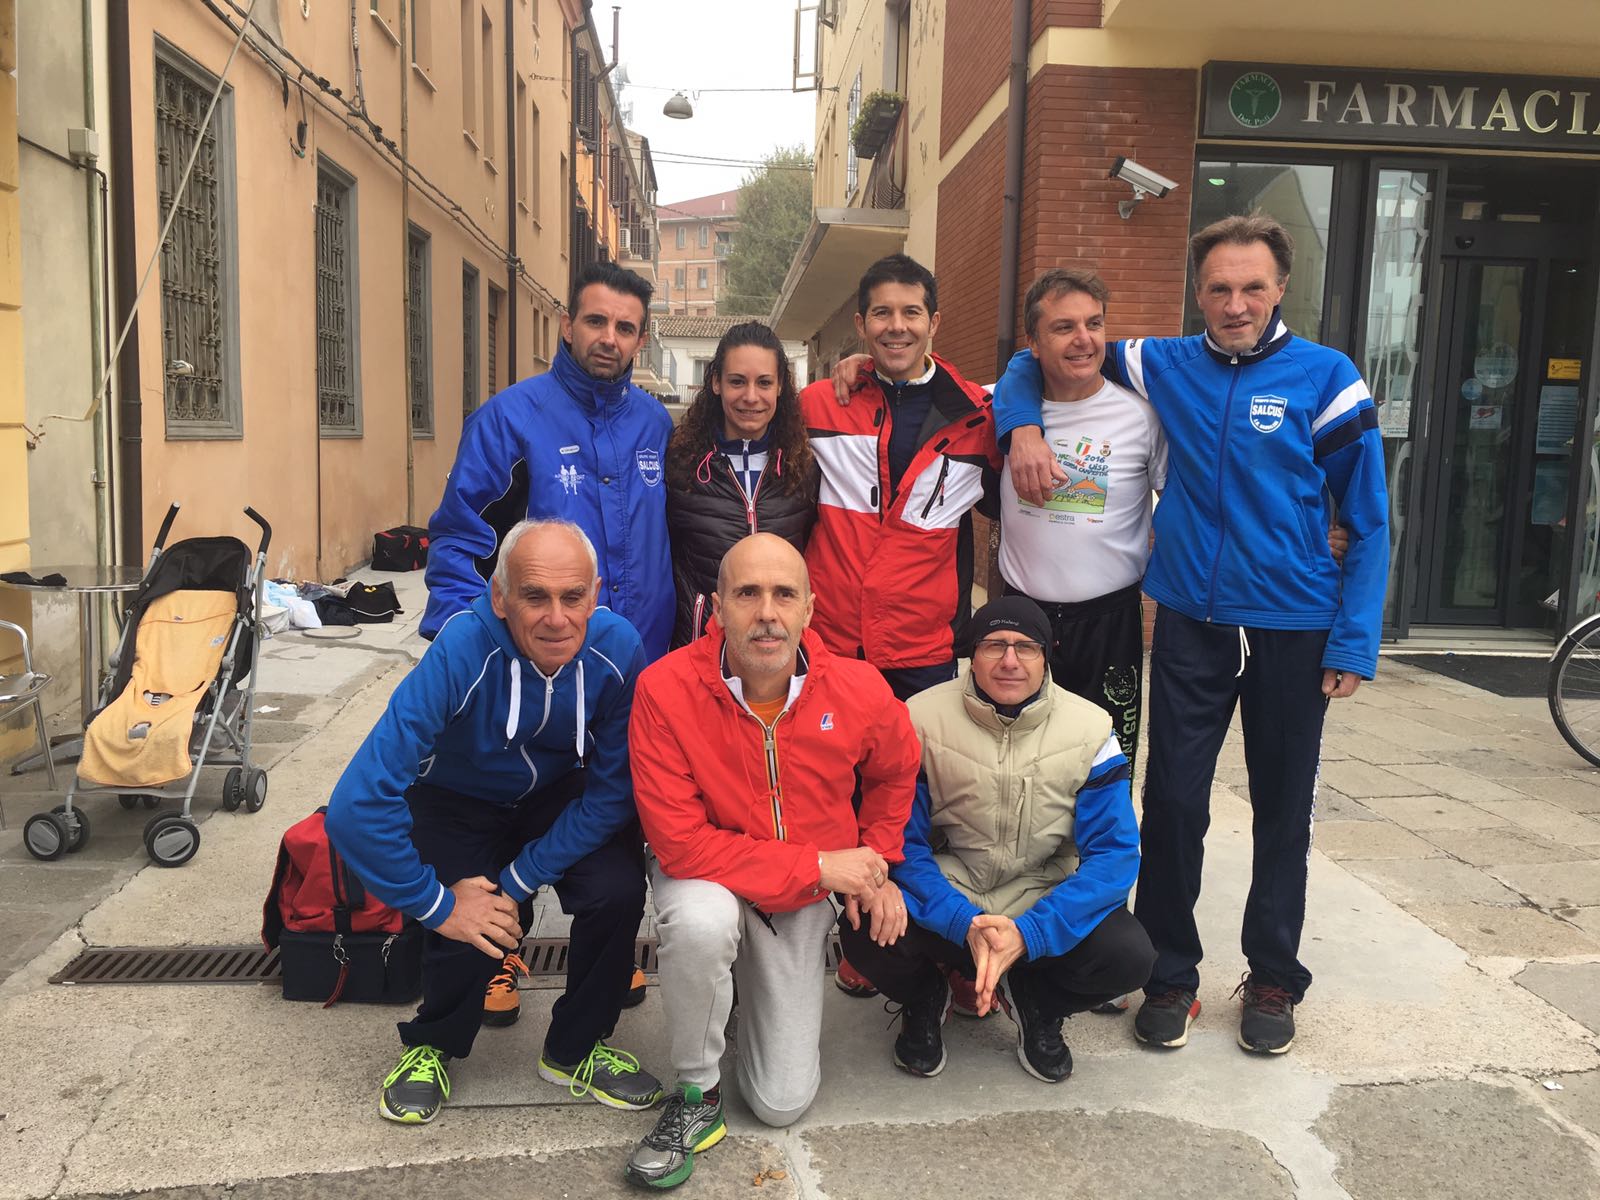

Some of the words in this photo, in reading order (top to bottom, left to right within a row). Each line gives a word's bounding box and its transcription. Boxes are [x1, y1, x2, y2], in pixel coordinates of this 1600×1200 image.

[1235, 75, 1276, 92] FARMACIA
[1301, 80, 1600, 136] FARMACI
[1251, 404, 1283, 418] SALCUS
[639, 460, 660, 470] SALCUS
[1084, 454, 1106, 463] 2016
